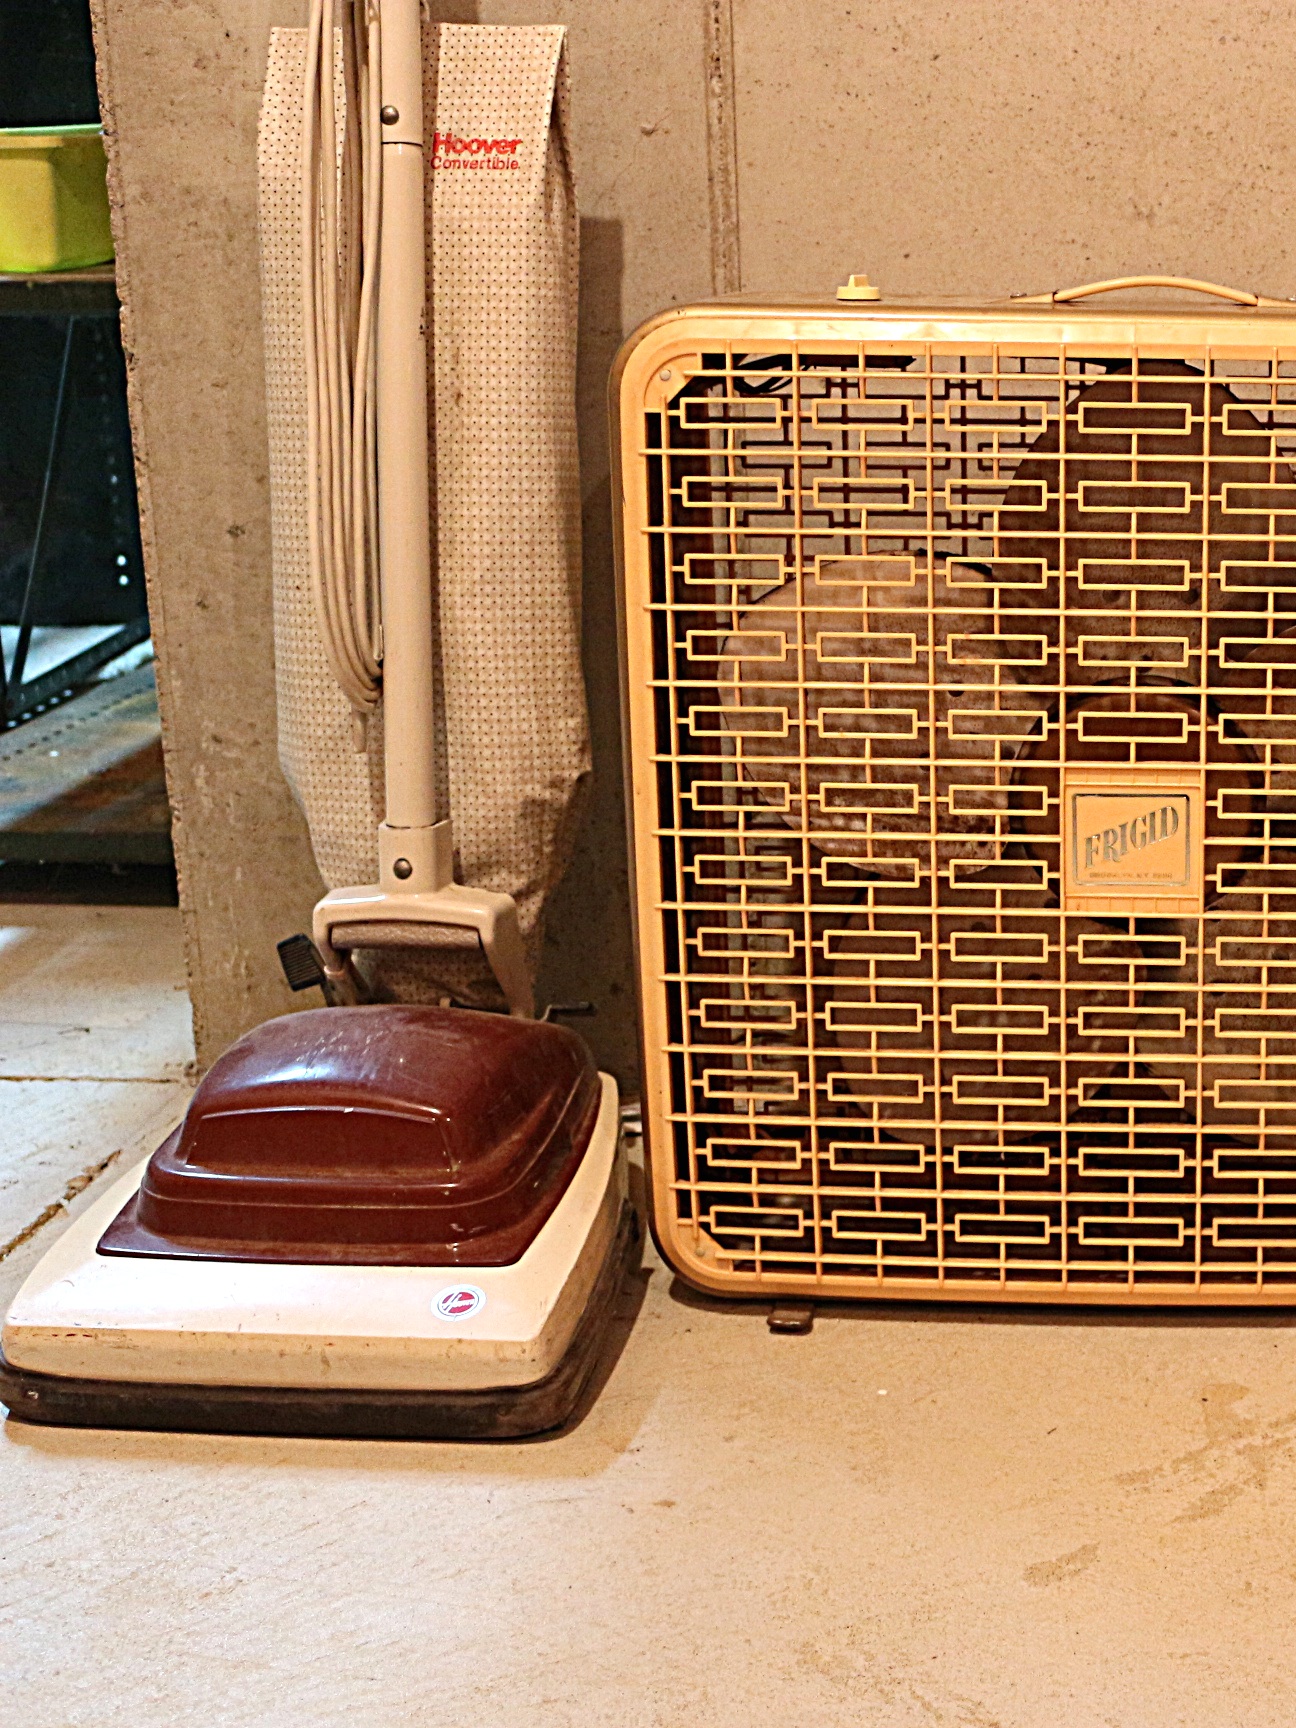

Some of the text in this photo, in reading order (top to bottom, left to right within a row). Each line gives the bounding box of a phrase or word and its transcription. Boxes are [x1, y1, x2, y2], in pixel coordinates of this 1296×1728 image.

[432, 132, 522, 154] Hoover
[430, 155, 519, 170] Convertible
[1084, 805, 1179, 869] FRIGID
